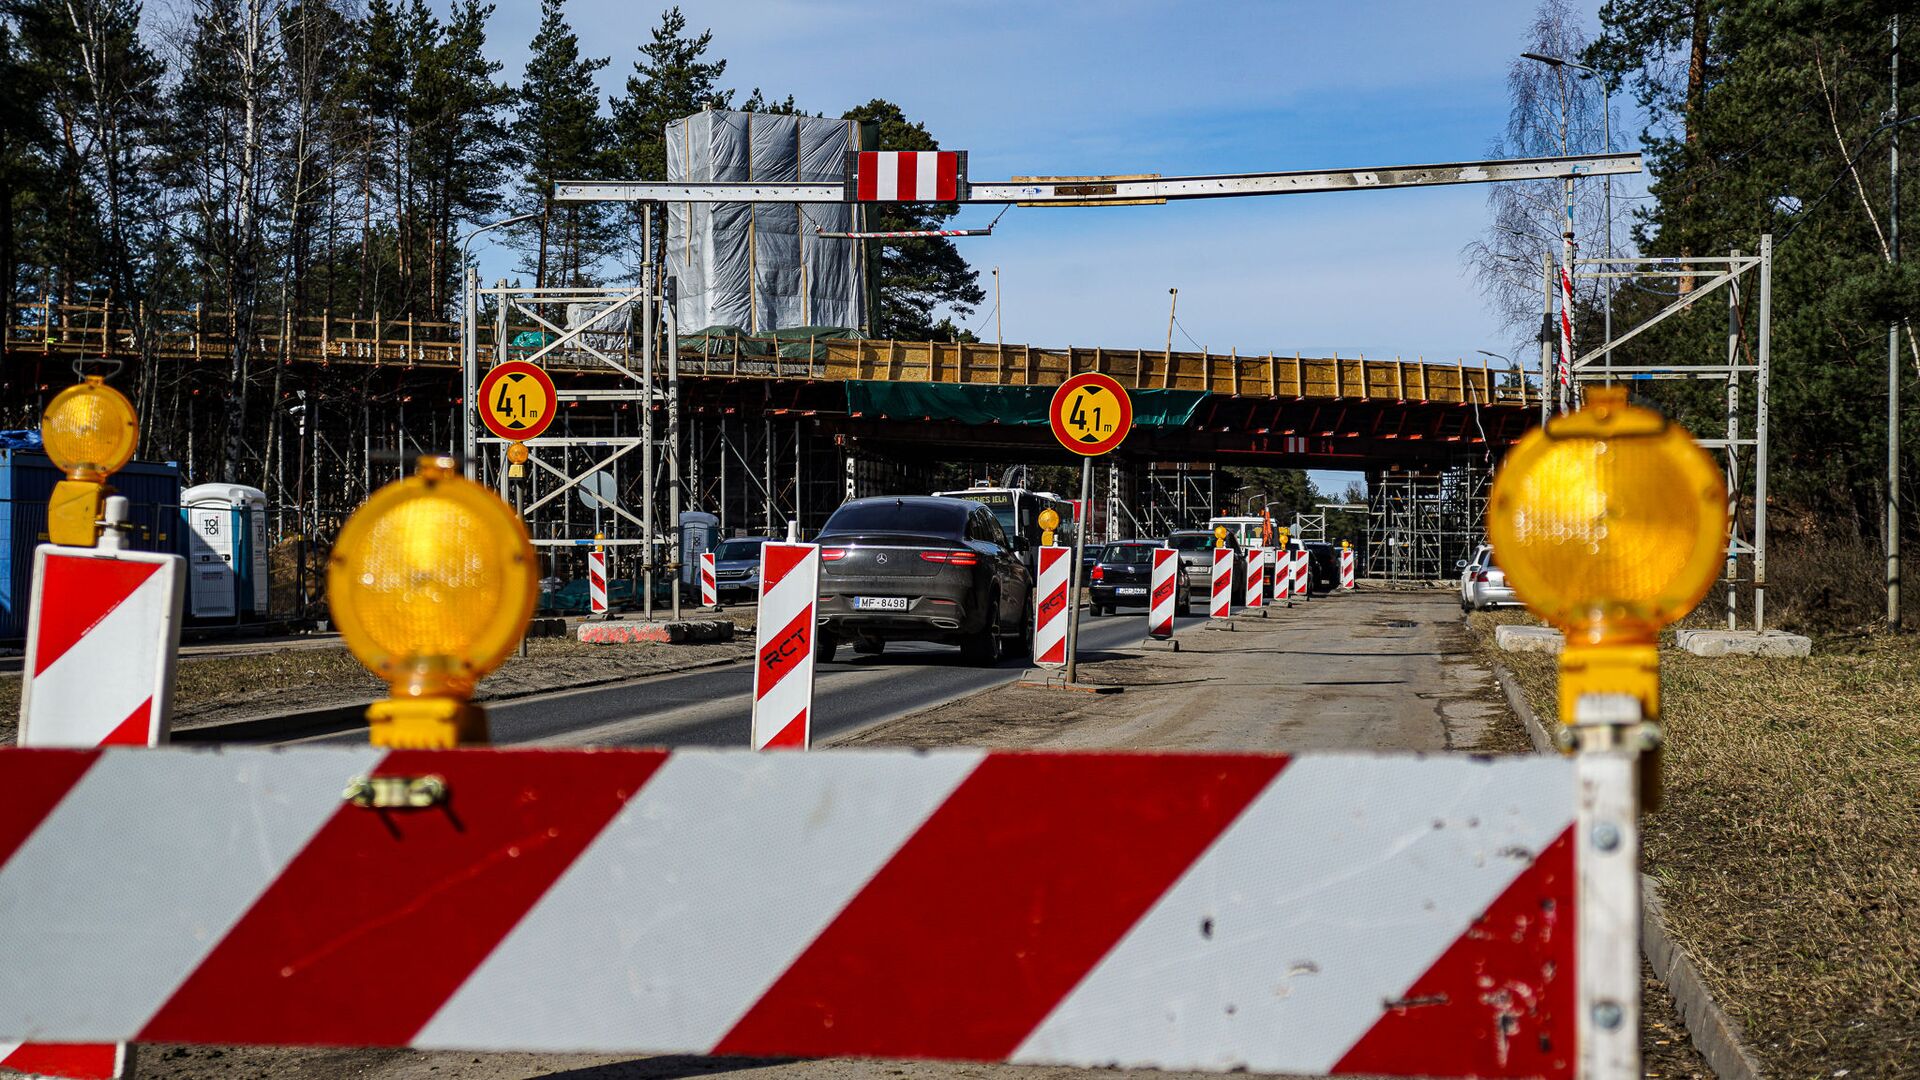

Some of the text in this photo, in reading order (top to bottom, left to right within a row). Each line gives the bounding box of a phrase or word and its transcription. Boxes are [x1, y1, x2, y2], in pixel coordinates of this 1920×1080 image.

[496, 383, 526, 419] 4,1
[1069, 395, 1101, 432] 4,1
[861, 598, 905, 608] MF-8498
[763, 627, 806, 670] RCT
